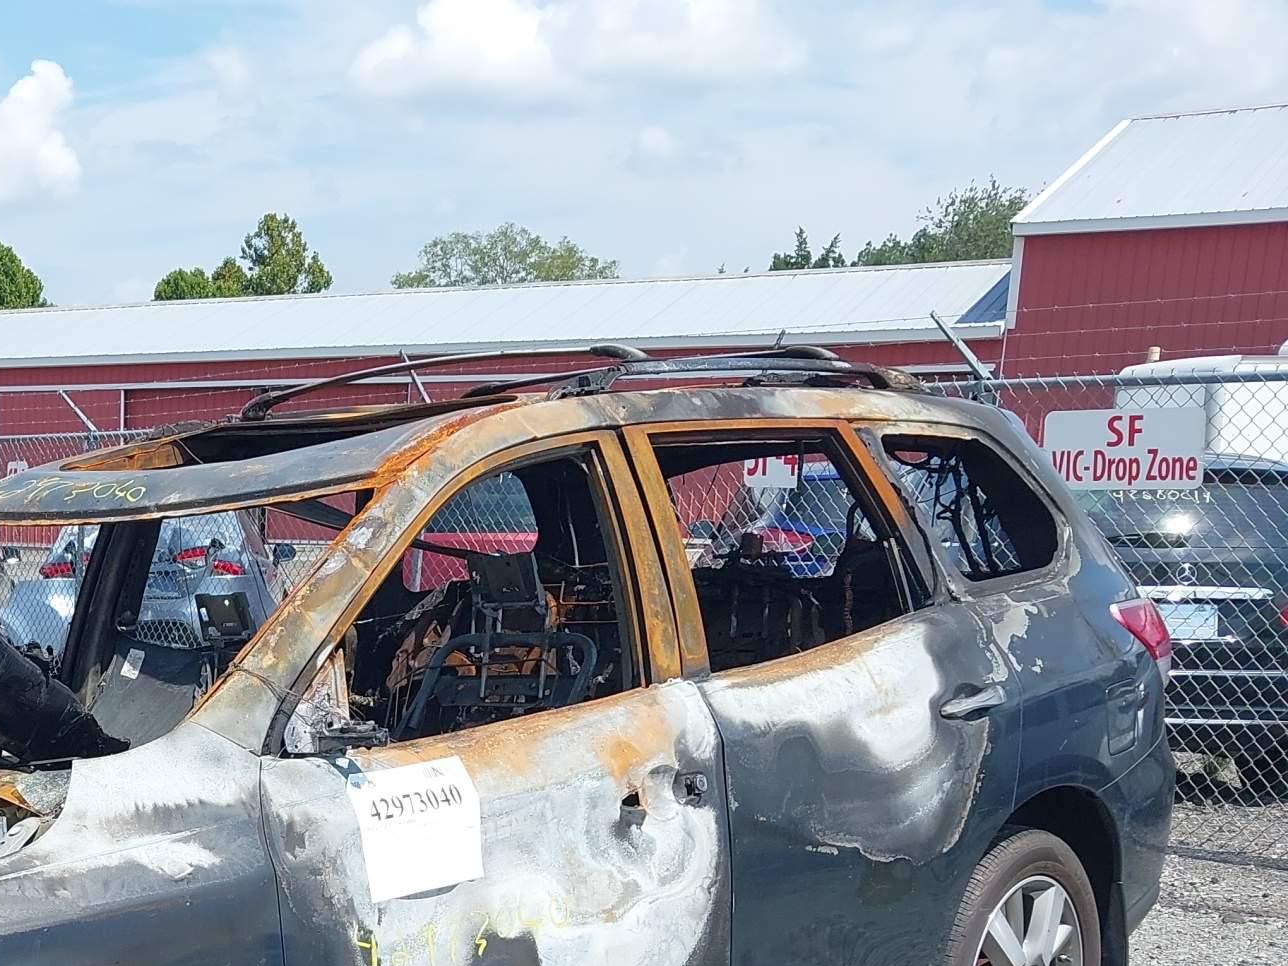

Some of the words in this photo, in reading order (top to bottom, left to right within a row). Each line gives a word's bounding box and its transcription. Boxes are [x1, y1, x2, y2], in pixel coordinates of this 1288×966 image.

[1106, 414, 1144, 448] SF
[1052, 449, 1141, 486] VIC-Drop
[1145, 448, 1198, 481] Zone
[370, 784, 462, 821] 42973040
